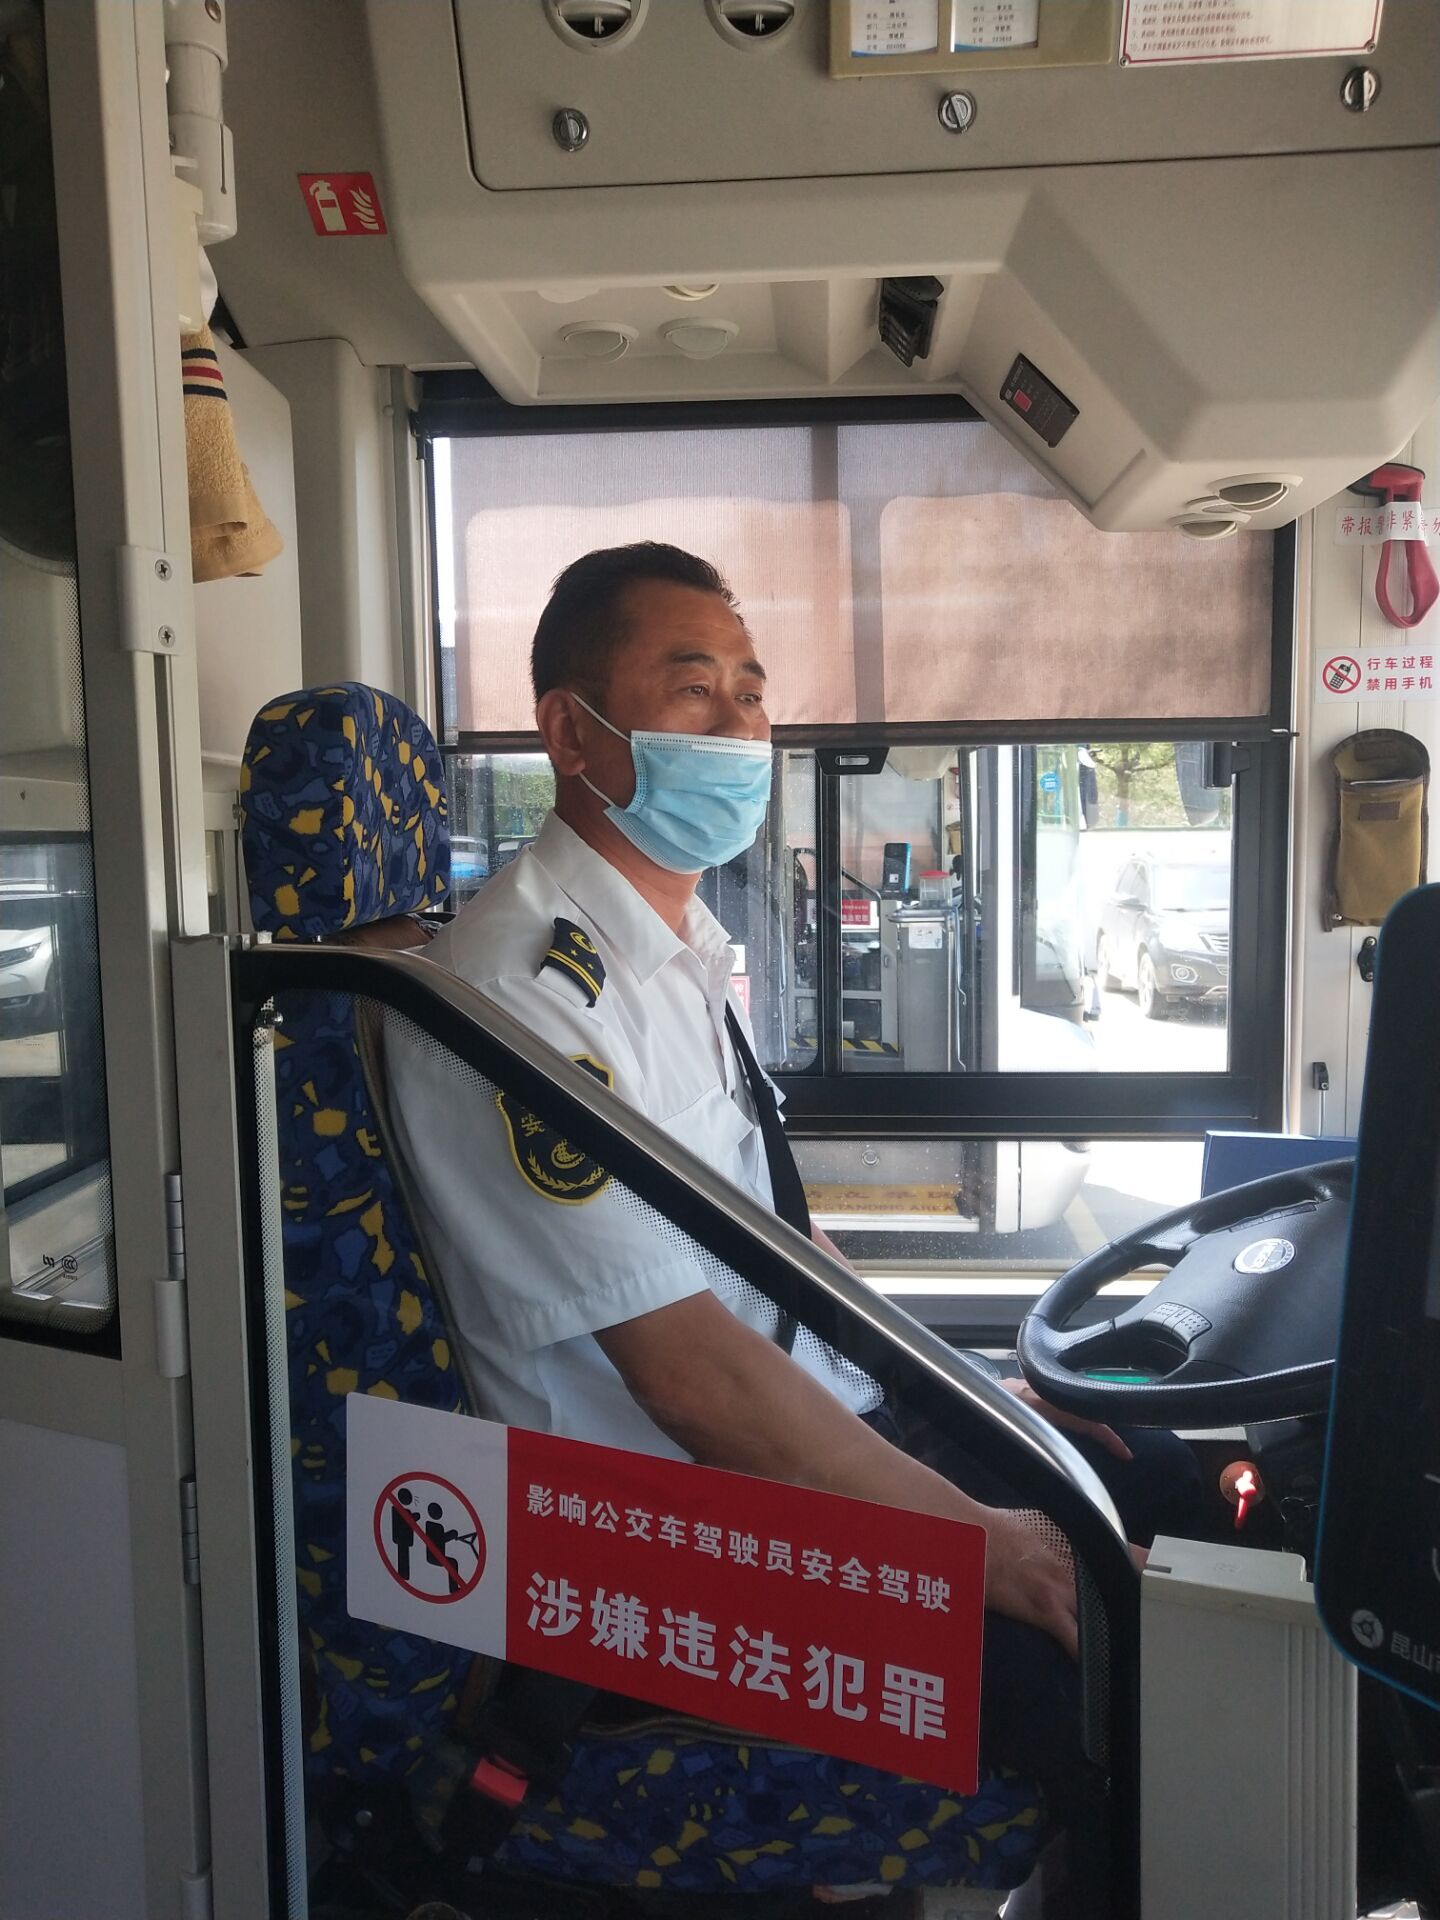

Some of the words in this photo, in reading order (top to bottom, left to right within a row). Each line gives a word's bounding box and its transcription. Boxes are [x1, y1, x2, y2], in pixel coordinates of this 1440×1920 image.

[1366, 676, 1433, 691] 禁用手机
[1367, 655, 1433, 671] 行车过程
[526, 1484, 951, 1614] 影响公交车驾驶员安全驾驶
[525, 1571, 947, 1740] 涉嫌违法犯罪
